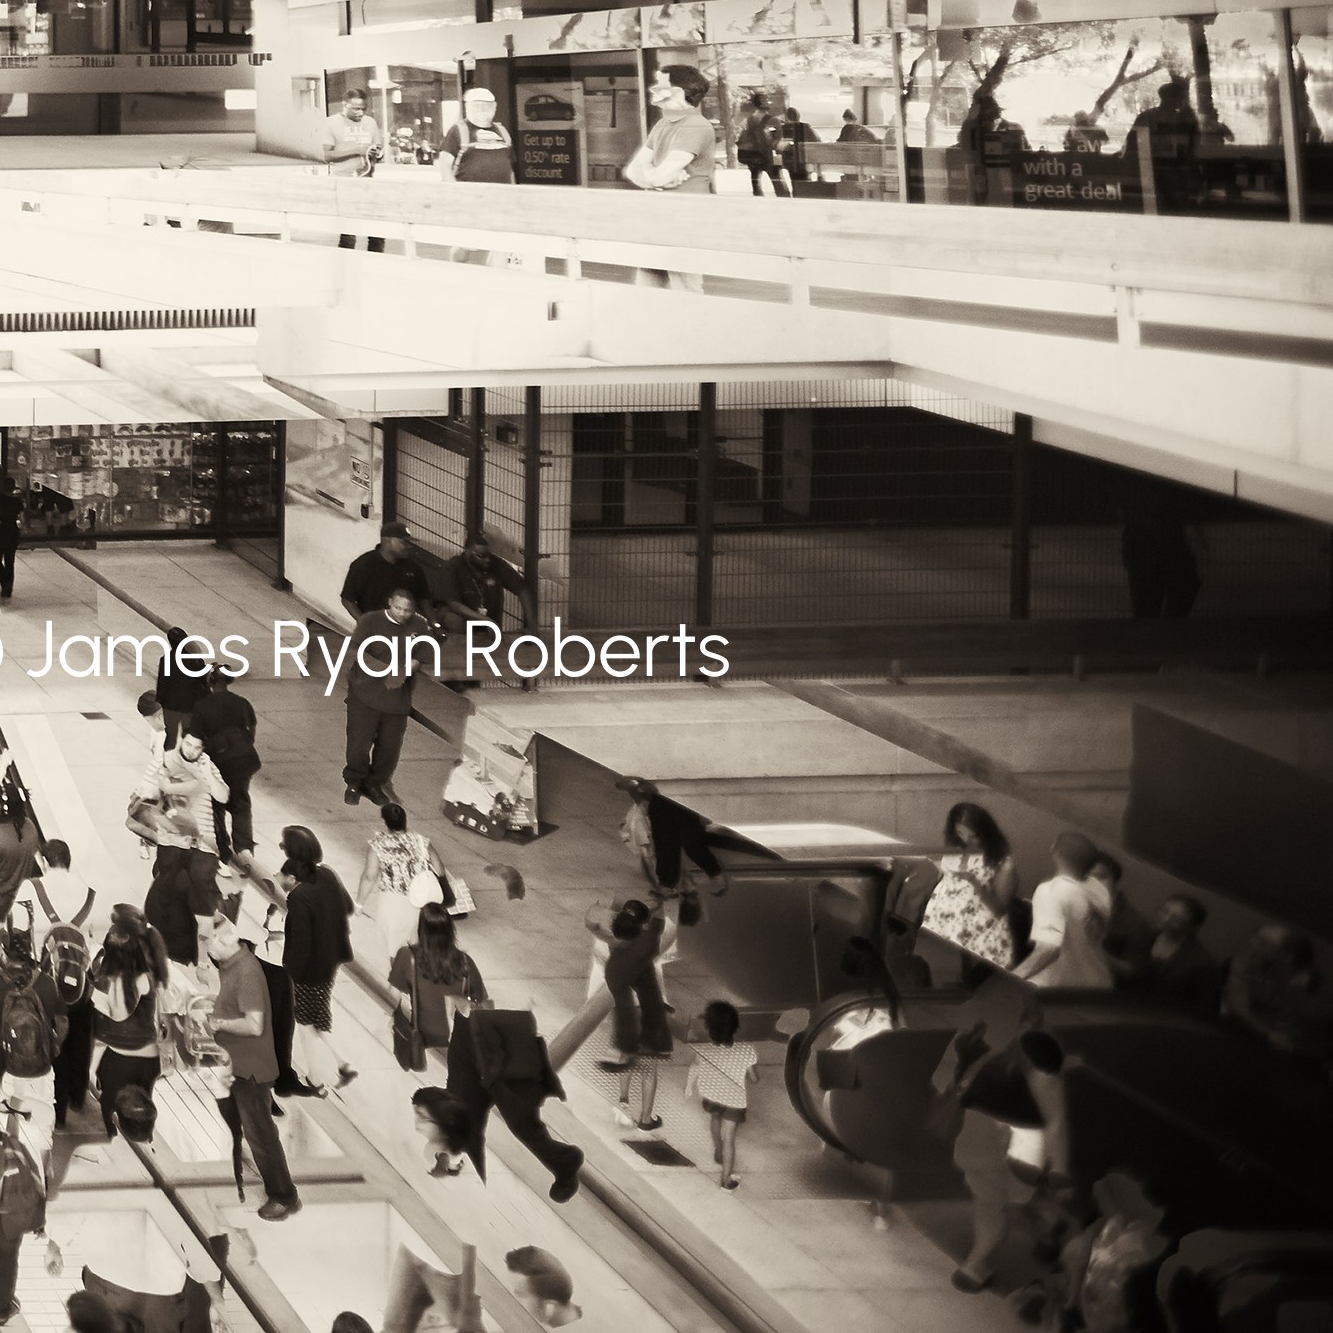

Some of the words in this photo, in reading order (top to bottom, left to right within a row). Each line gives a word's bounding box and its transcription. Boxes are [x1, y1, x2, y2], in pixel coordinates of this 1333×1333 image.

[524, 133, 540, 146] Get
[542, 137, 554, 149] up
[555, 135, 567, 147] to
[551, 153, 571, 165] rate
[1023, 157, 1066, 176] with
[1071, 162, 1083, 176] a
[525, 166, 564, 179] discount
[1024, 182, 1076, 202] great
[1081, 181, 1122, 201] deal
